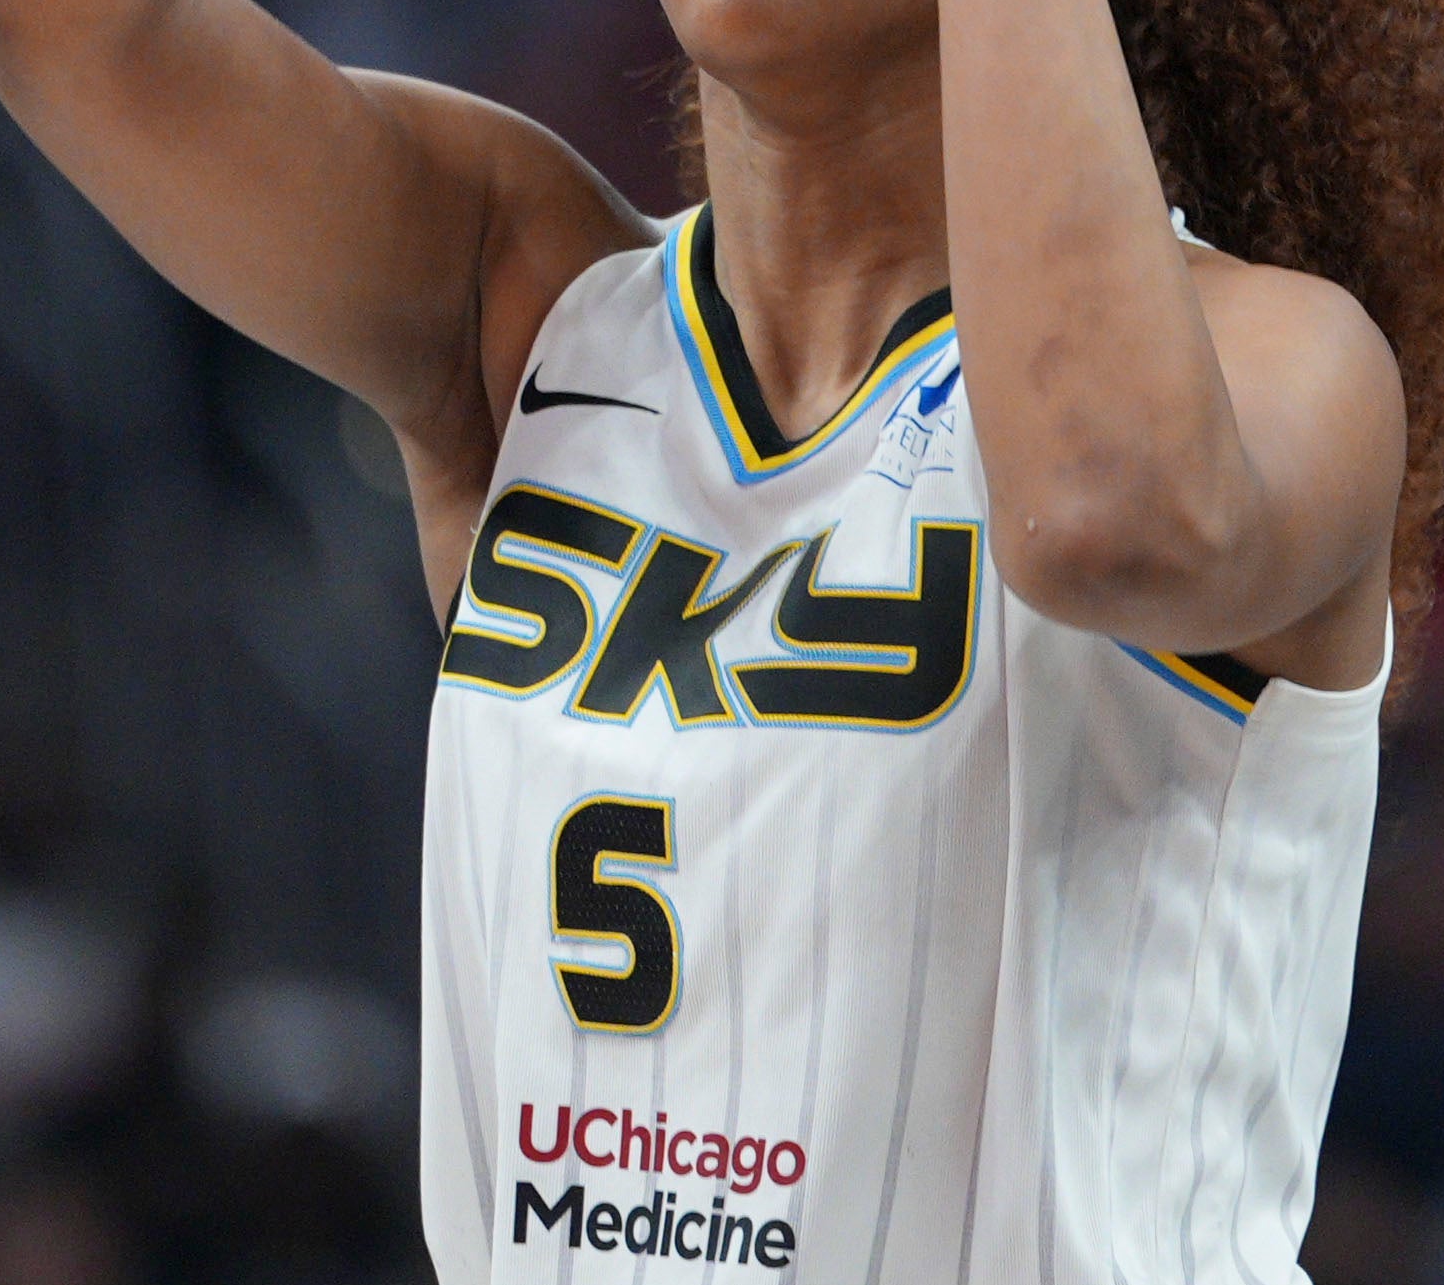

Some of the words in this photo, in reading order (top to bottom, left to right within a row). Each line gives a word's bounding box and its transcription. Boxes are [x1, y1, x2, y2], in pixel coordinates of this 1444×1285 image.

[439, 477, 985, 735] SKY
[548, 789, 684, 1036] 5
[512, 1181, 796, 1268] Medicine
[518, 1103, 807, 1194] UChicago
